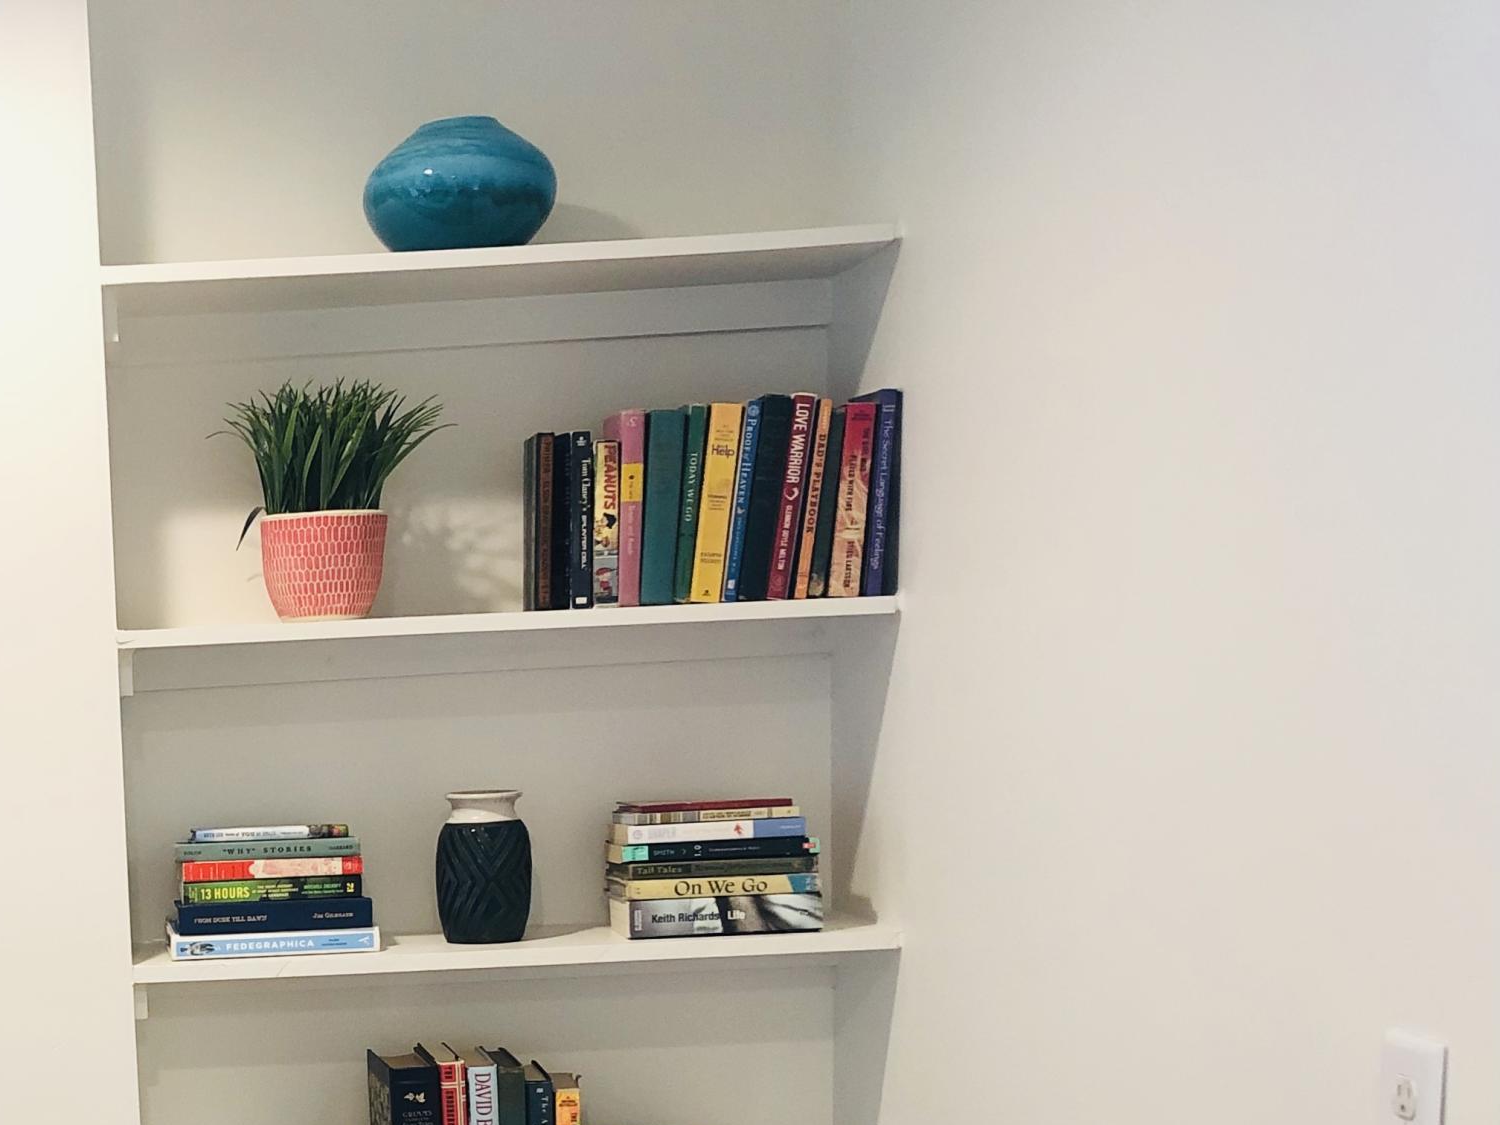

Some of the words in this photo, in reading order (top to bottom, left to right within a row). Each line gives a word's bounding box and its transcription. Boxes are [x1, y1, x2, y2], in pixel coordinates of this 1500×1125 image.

[793, 403, 811, 431] LOVE
[883, 419, 894, 439] The
[744, 418, 758, 451] PROOF
[786, 434, 806, 484] WARRIOR
[814, 433, 826, 468] DAD'S
[880, 439, 892, 470] Secret
[581, 458, 591, 477] Tom
[603, 444, 617, 510] PEANUTS
[687, 453, 698, 484] TODAY
[578, 478, 591, 511] Clancy's
[686, 488, 696, 503] WE
[737, 462, 752, 504] HEAVEN
[874, 471, 887, 518] Language
[684, 506, 693, 522] GO
[806, 471, 821, 533] PLAYBOOK
[875, 519, 886, 529] of
[870, 531, 884, 570] Feelings
[262, 845, 312, 854] STORIES
[200, 888, 212, 900] 13
[214, 886, 250, 899] HOURS
[674, 881, 701, 896] On
[708, 880, 735, 894] We
[741, 878, 768, 893] Go
[651, 912, 676, 924] Keith
[678, 911, 720, 923] Richards
[727, 910, 746, 920] Life
[226, 939, 315, 951] FEDEGRAPHICA
[474, 1073, 493, 1116] DAVID
[541, 1095, 549, 1113] The
